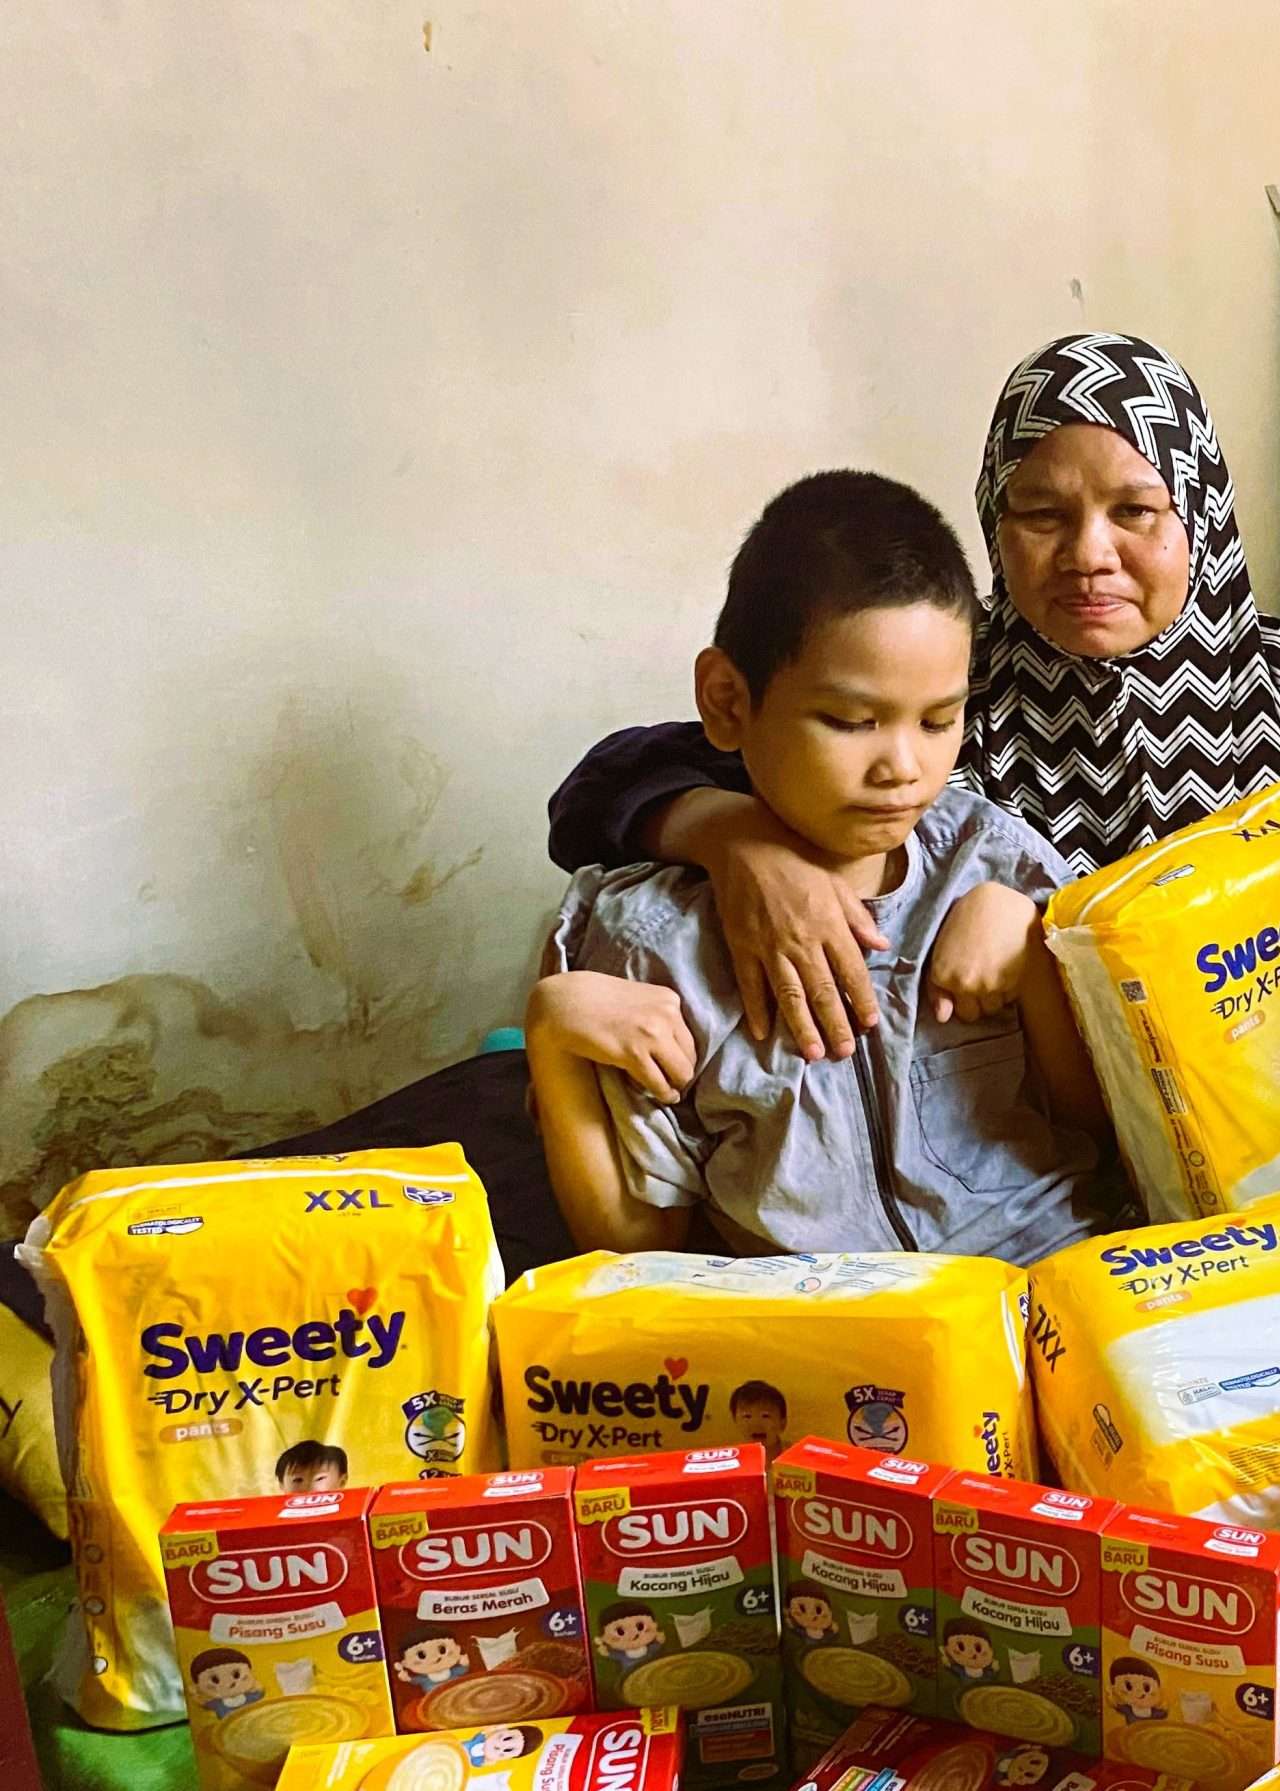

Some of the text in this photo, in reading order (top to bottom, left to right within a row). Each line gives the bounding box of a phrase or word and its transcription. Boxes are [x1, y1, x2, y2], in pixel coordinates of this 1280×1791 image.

[1211, 987, 1253, 1019] Dry
[304, 1189, 393, 1213] XXL
[1100, 1223, 1278, 1276] Sweety
[1119, 1255, 1250, 1296] Dry X-Pert
[141, 1309, 406, 1380] Sweety
[1031, 1304, 1067, 1374] XXL
[148, 1373, 341, 1417] Dry X-Pert
[411, 1392, 437, 1411] 5X
[524, 1365, 710, 1432] Sweety
[853, 1386, 876, 1404] 5X
[531, 1421, 663, 1449] Dry X-Pert
[981, 1411, 1002, 1478] eety
[884, 1459, 925, 1473] SUN
[775, 1478, 812, 1493] BARU
[580, 1497, 625, 1517] BARU
[1046, 1493, 1087, 1508] SUN
[376, 1521, 423, 1541] BARU
[618, 1506, 730, 1549] SUN
[804, 1501, 897, 1550] SUN
[936, 1513, 975, 1529] BARU
[1219, 1528, 1261, 1543] SUN
[165, 1541, 212, 1561] BARU
[415, 1528, 533, 1572] SUN
[1103, 1551, 1145, 1567] BARU
[206, 1551, 328, 1595] SUN
[965, 1536, 1063, 1588] SUN
[630, 1571, 730, 1593] Kacang Hijau
[811, 1563, 859, 1590] Kacang
[862, 1578, 896, 1594] Hijau
[432, 1593, 534, 1616] Beras Merah
[742, 1589, 769, 1609] 6+
[1134, 1574, 1239, 1626] SUN
[549, 1611, 577, 1632] 6+
[904, 1607, 929, 1627] 6+
[972, 1600, 1060, 1632] Kacang Hijau
[229, 1619, 326, 1640] Pisang Susu
[345, 1635, 376, 1656] 6+
[1069, 1646, 1094, 1667] 6+
[1145, 1641, 1192, 1667] Pisang
[1196, 1654, 1230, 1670] Susu
[1242, 1686, 1269, 1708] 6+
[540, 1742, 566, 1777] Pisang
[597, 1729, 642, 1791] SUN
[541, 1778, 554, 1791] Su
